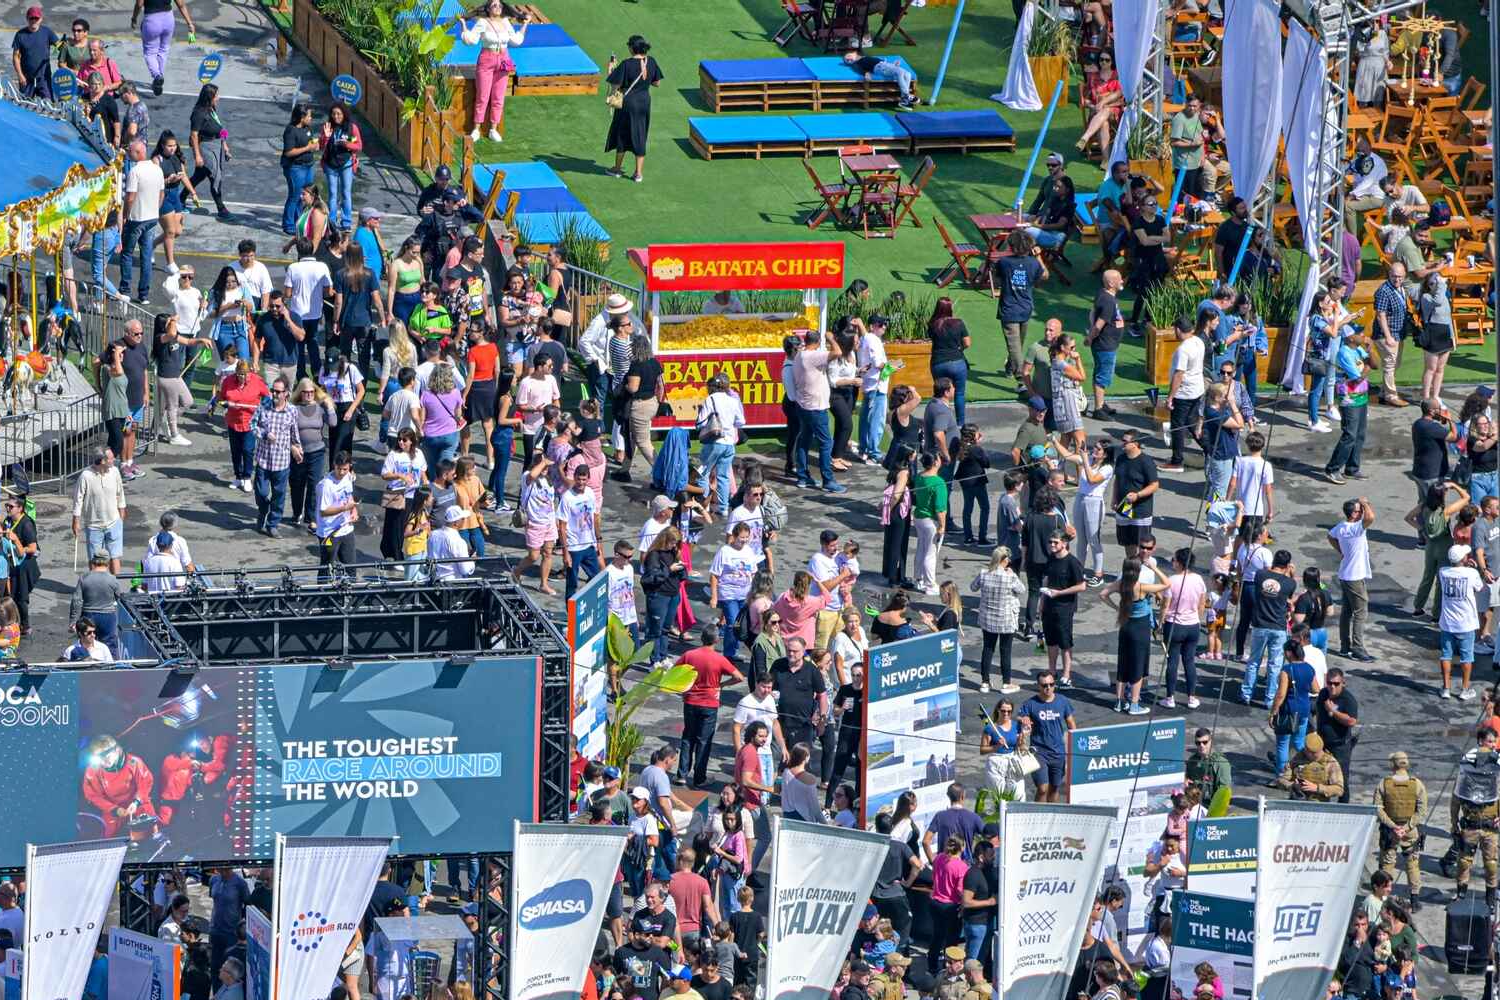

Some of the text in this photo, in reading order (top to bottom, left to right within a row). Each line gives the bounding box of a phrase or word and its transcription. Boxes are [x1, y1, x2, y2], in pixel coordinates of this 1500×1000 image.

[336, 80, 357, 92] CAIXA
[689, 258, 841, 277] BATATA CHIPS
[663, 360, 772, 384] BATATA
[881, 662, 943, 688] NEWPORT
[282, 736, 458, 759] THE TOUGHEST
[282, 753, 500, 783] RACE AROUND
[1087, 752, 1151, 771] AARHUS
[282, 780, 419, 801] THE WORLD
[1021, 841, 1063, 853] SANTA
[1273, 842, 1350, 864] GERMÂNIA
[1020, 851, 1084, 863] CATARINA
[779, 887, 857, 903] SANTA CATARINA
[521, 899, 587, 922] SEMASA
[1190, 903, 1210, 911] OCEAN
[33, 921, 97, 944] VOLVO
[1189, 923, 1221, 940] THE
[119, 936, 154, 951] BIOTHERM
